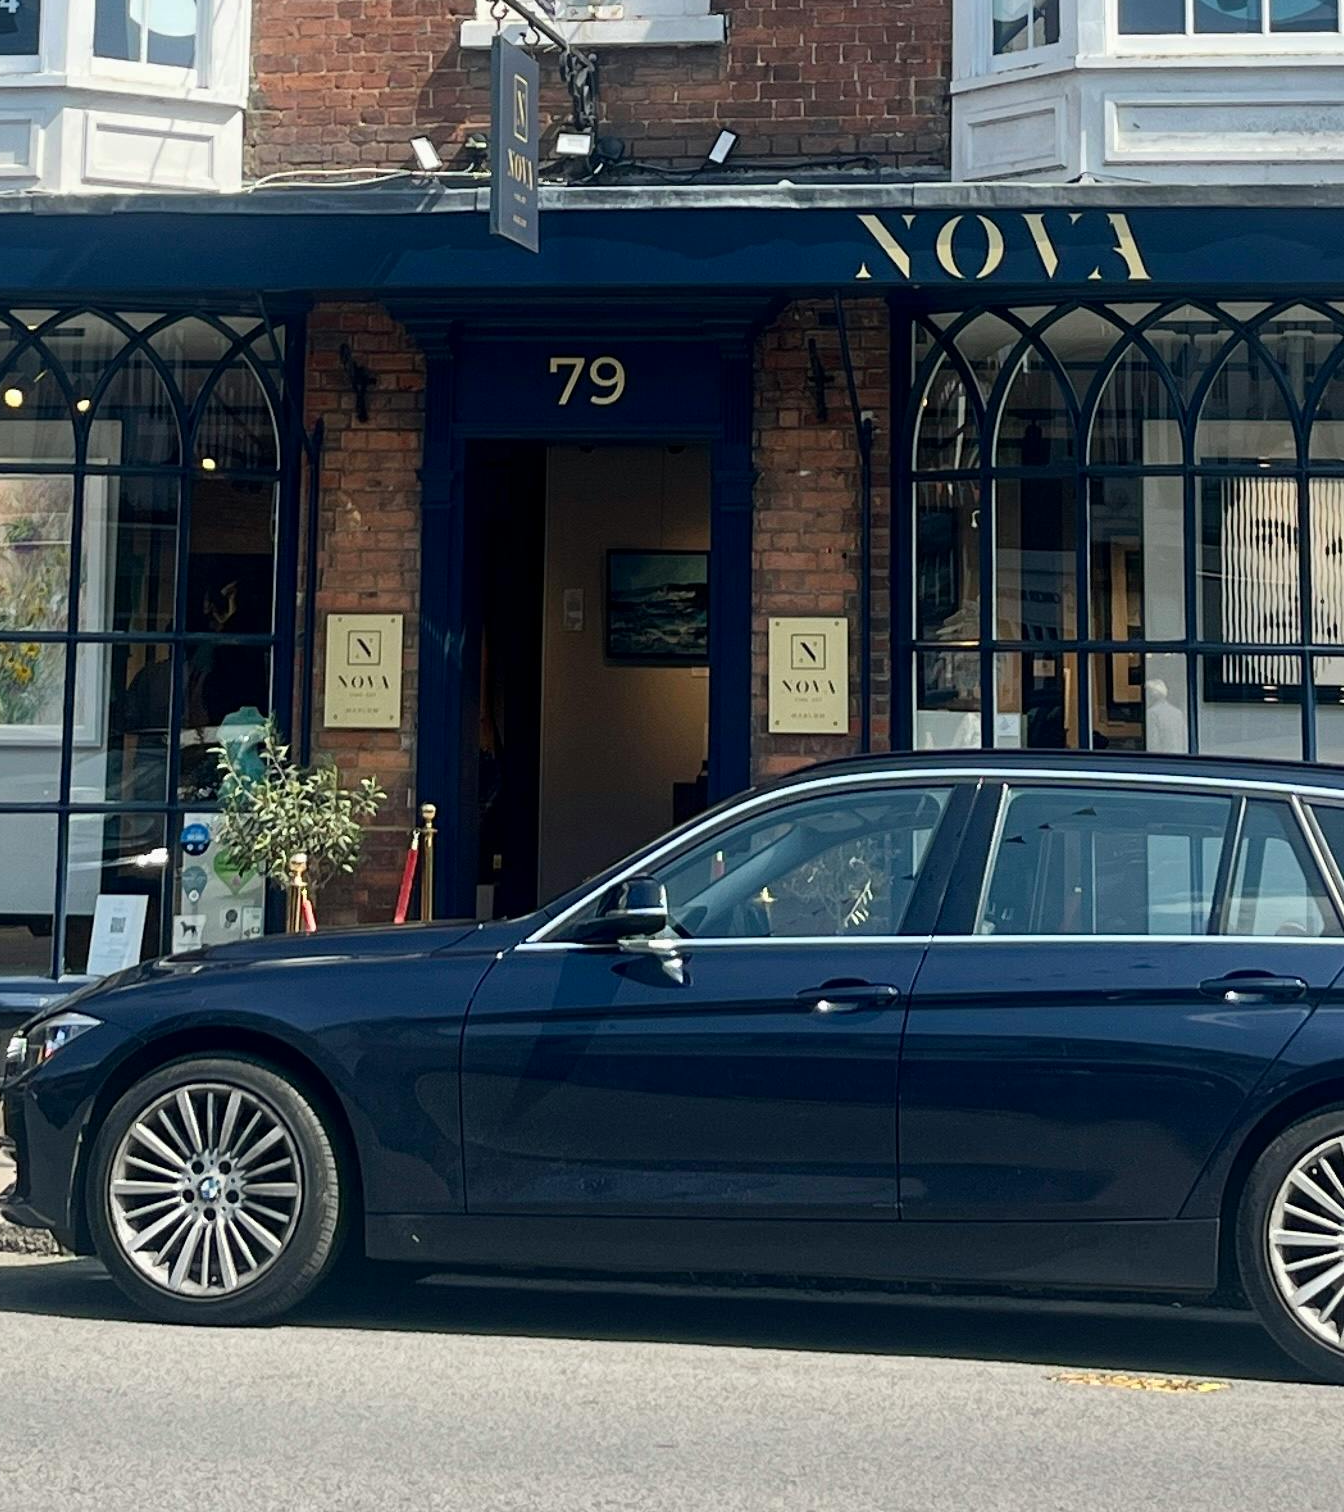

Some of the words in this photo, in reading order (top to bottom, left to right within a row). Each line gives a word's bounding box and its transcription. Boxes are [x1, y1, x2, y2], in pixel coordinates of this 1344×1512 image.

[855, 213, 1152, 280] NOVA
[549, 356, 625, 405] 79
[337, 675, 390, 690] NOVA
[781, 679, 836, 695] NOVA
